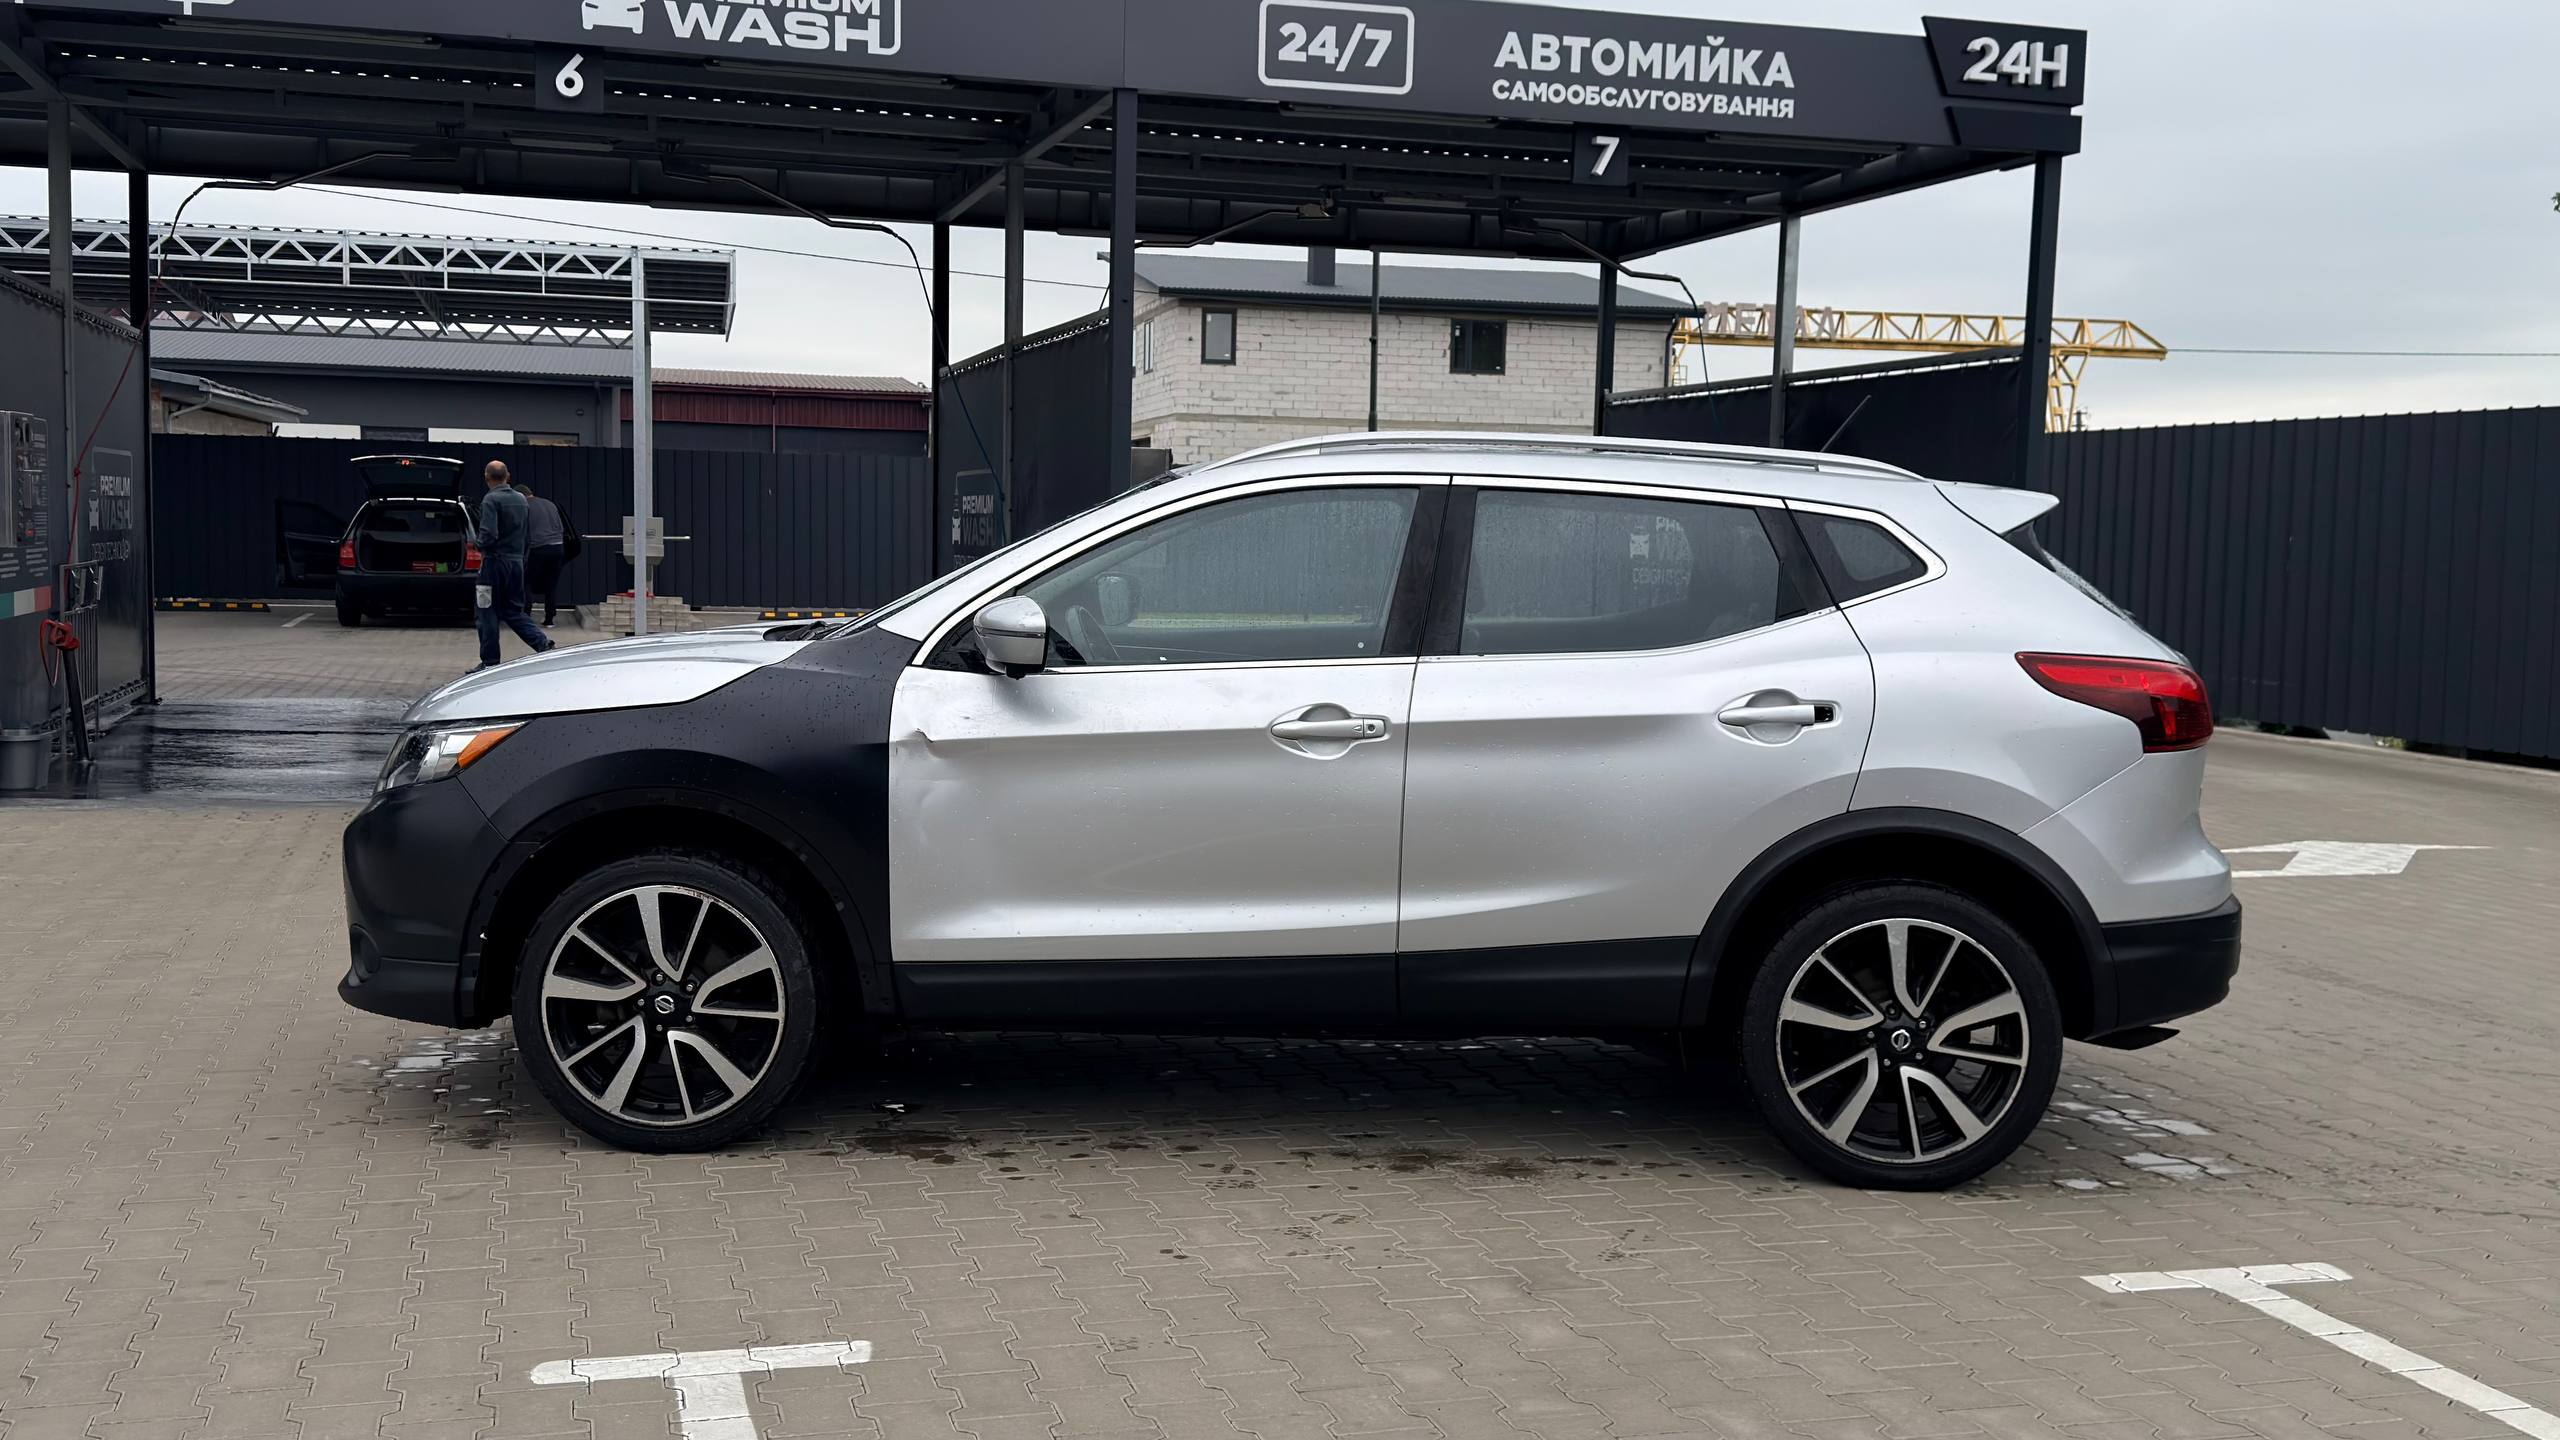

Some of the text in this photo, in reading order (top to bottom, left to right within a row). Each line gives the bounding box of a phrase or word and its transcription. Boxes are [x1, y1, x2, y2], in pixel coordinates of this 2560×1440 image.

[663, 0, 881, 54] WASH
[1278, 22, 1393, 72] 24/7
[555, 53, 584, 97] 6
[1493, 31, 1795, 88] АВТОМИЙКА
[1962, 36, 2069, 88] 24H
[1491, 79, 1795, 119] САМООБСЛУГОВУВАННЯ
[1590, 135, 1620, 177] 7
[100, 475, 131, 497] PREMIUM
[962, 495, 994, 514] PREMIUM
